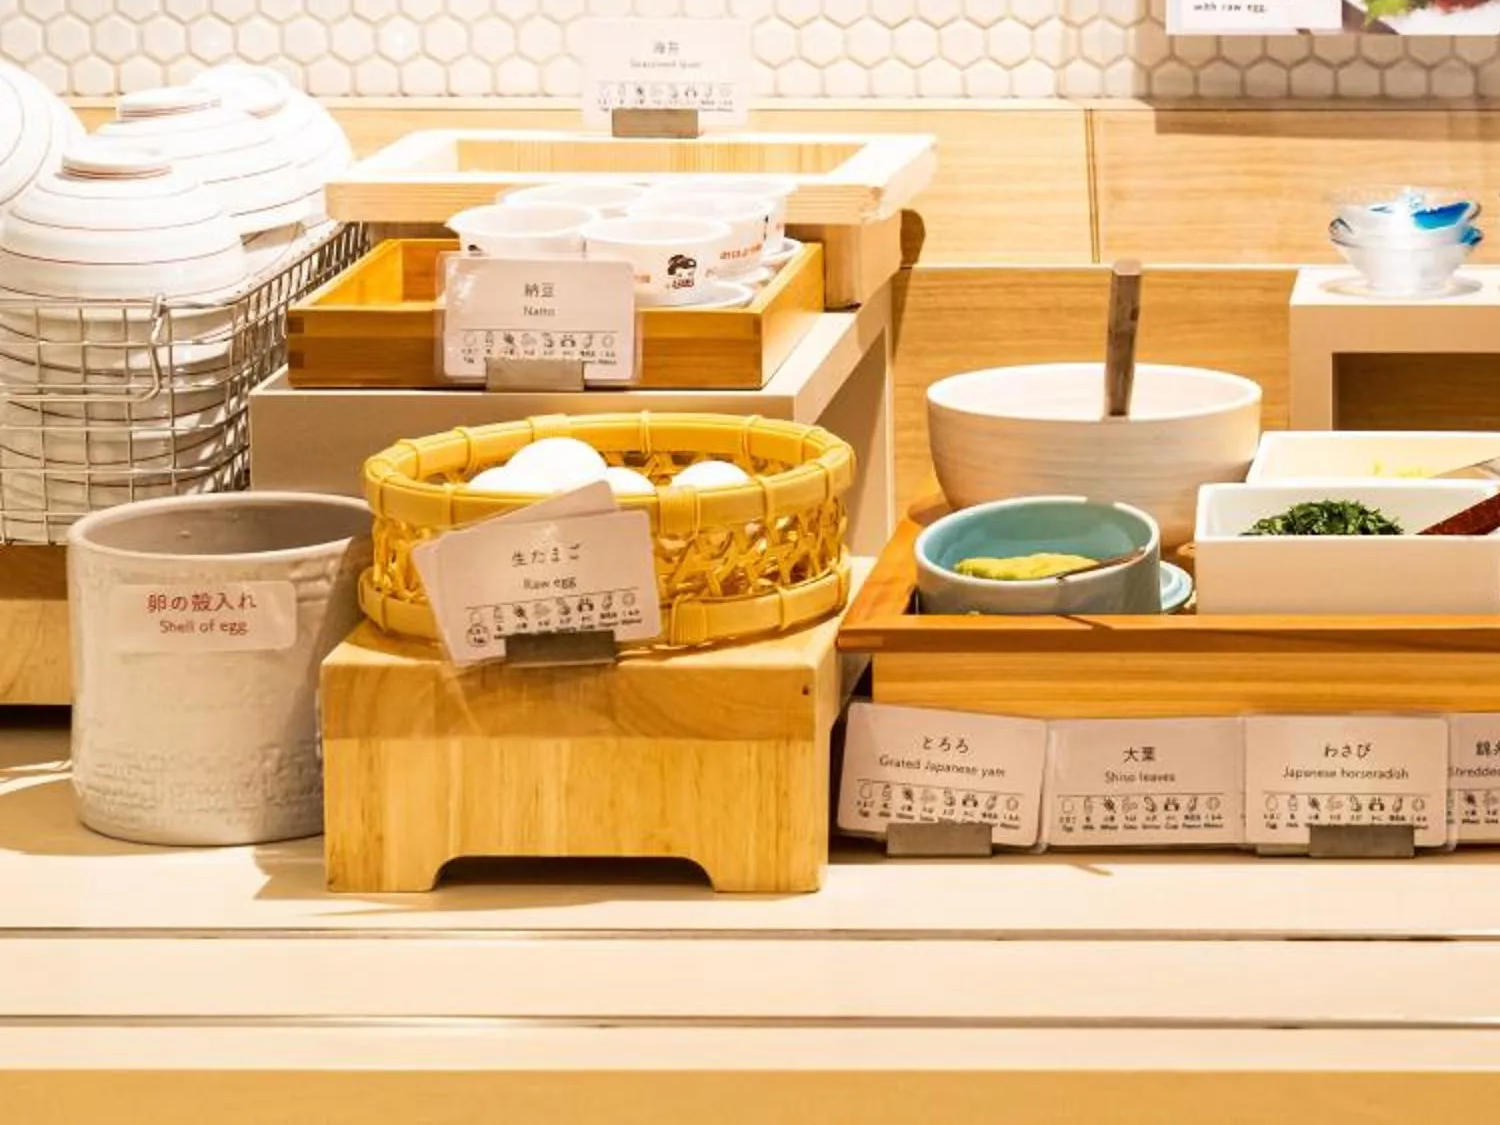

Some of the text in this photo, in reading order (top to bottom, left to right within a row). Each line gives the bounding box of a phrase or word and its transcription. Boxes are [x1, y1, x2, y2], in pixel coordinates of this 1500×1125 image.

[524, 282, 555, 298] 納豆
[147, 592, 257, 613] 卵の殻入れ
[159, 619, 248, 636] Shell of egg
[922, 736, 970, 754] とろろ
[1323, 742, 1371, 759] わさび
[879, 755, 921, 770] Grated
[1123, 746, 1156, 763] 大葉
